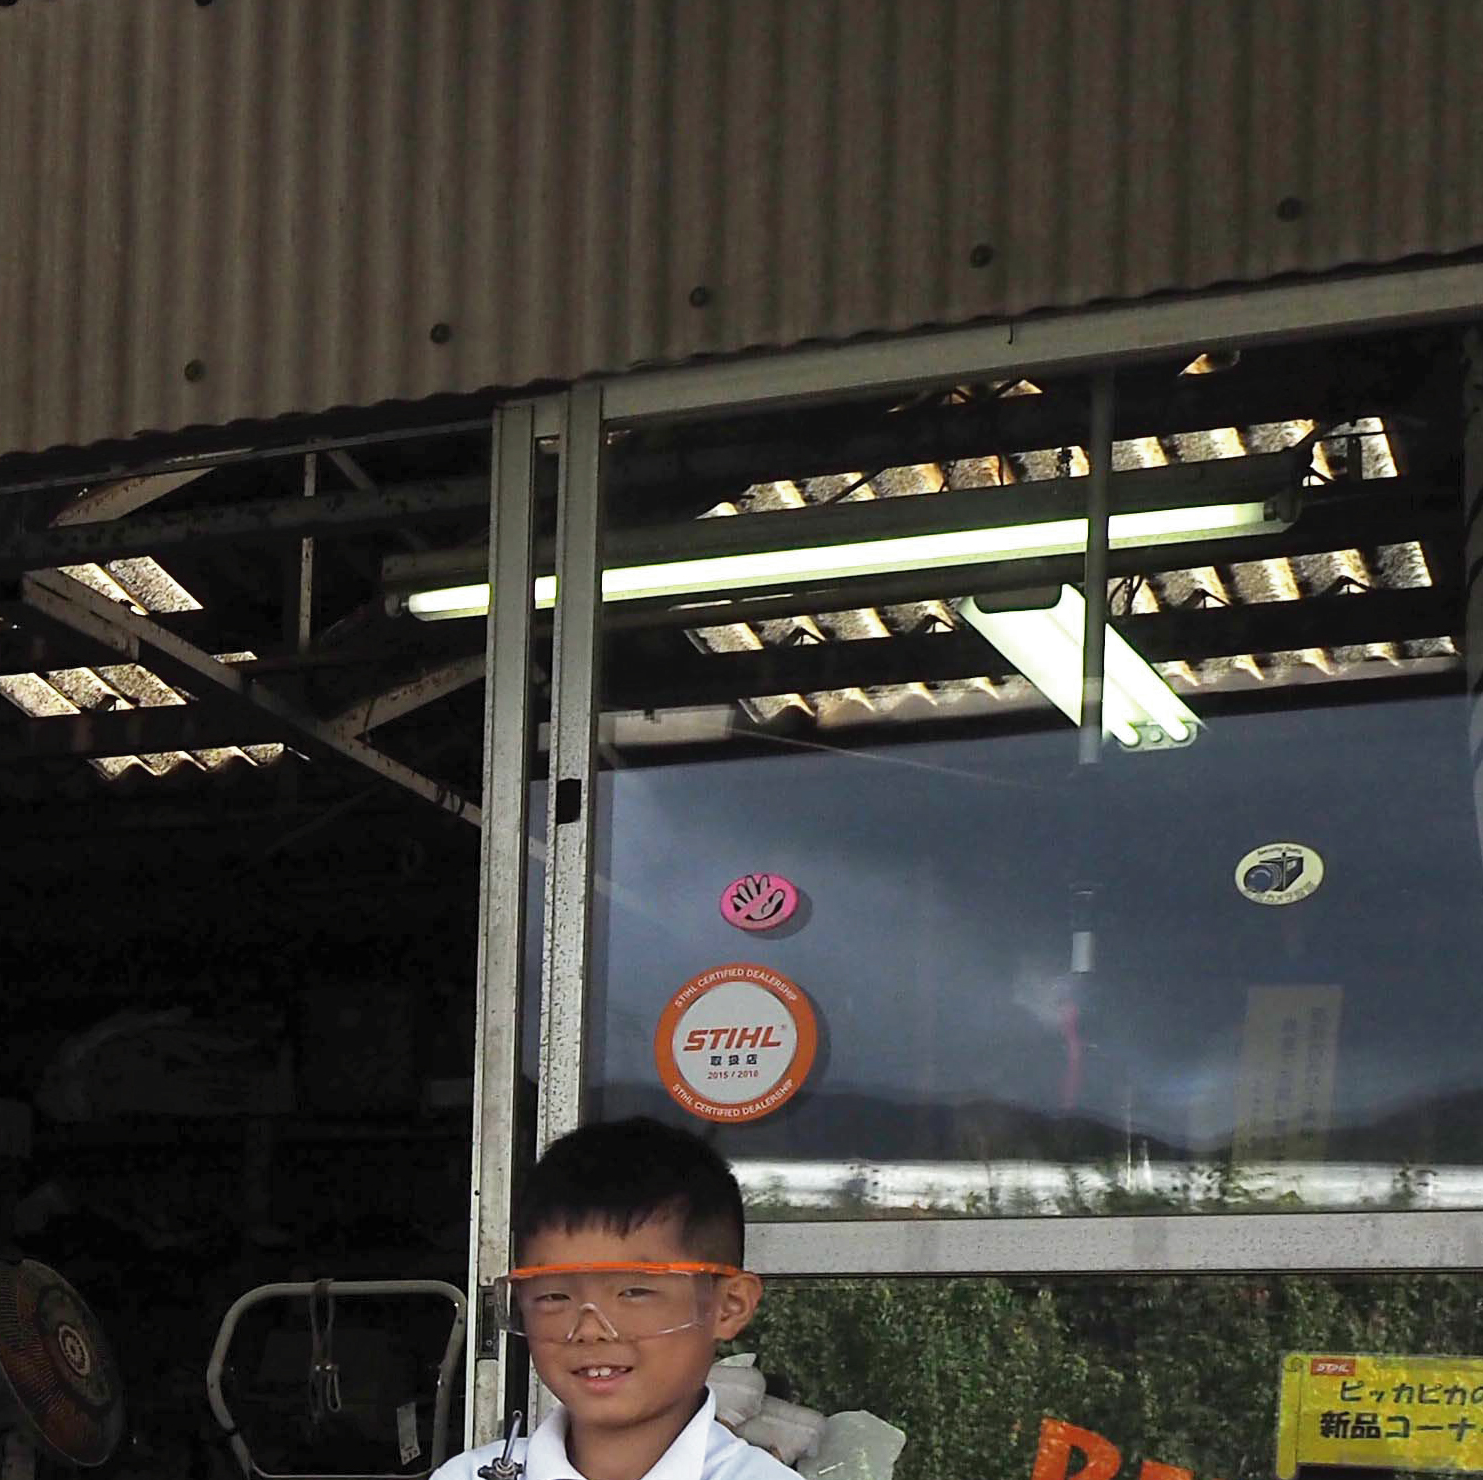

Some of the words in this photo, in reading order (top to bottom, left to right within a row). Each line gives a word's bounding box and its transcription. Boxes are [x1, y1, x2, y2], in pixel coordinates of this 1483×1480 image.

[674, 984, 699, 1008] STIHL
[697, 968, 745, 987] CERTIFIED
[746, 968, 798, 1002] DEALERSHIP
[683, 1026, 782, 1051] STIHL
[673, 1083, 693, 1105] STIHL
[694, 1102, 741, 1118] CERTIFIED
[742, 1078, 794, 1115] DEALERSHIP
[1320, 1410, 1483, 1442] 新品コーナ
